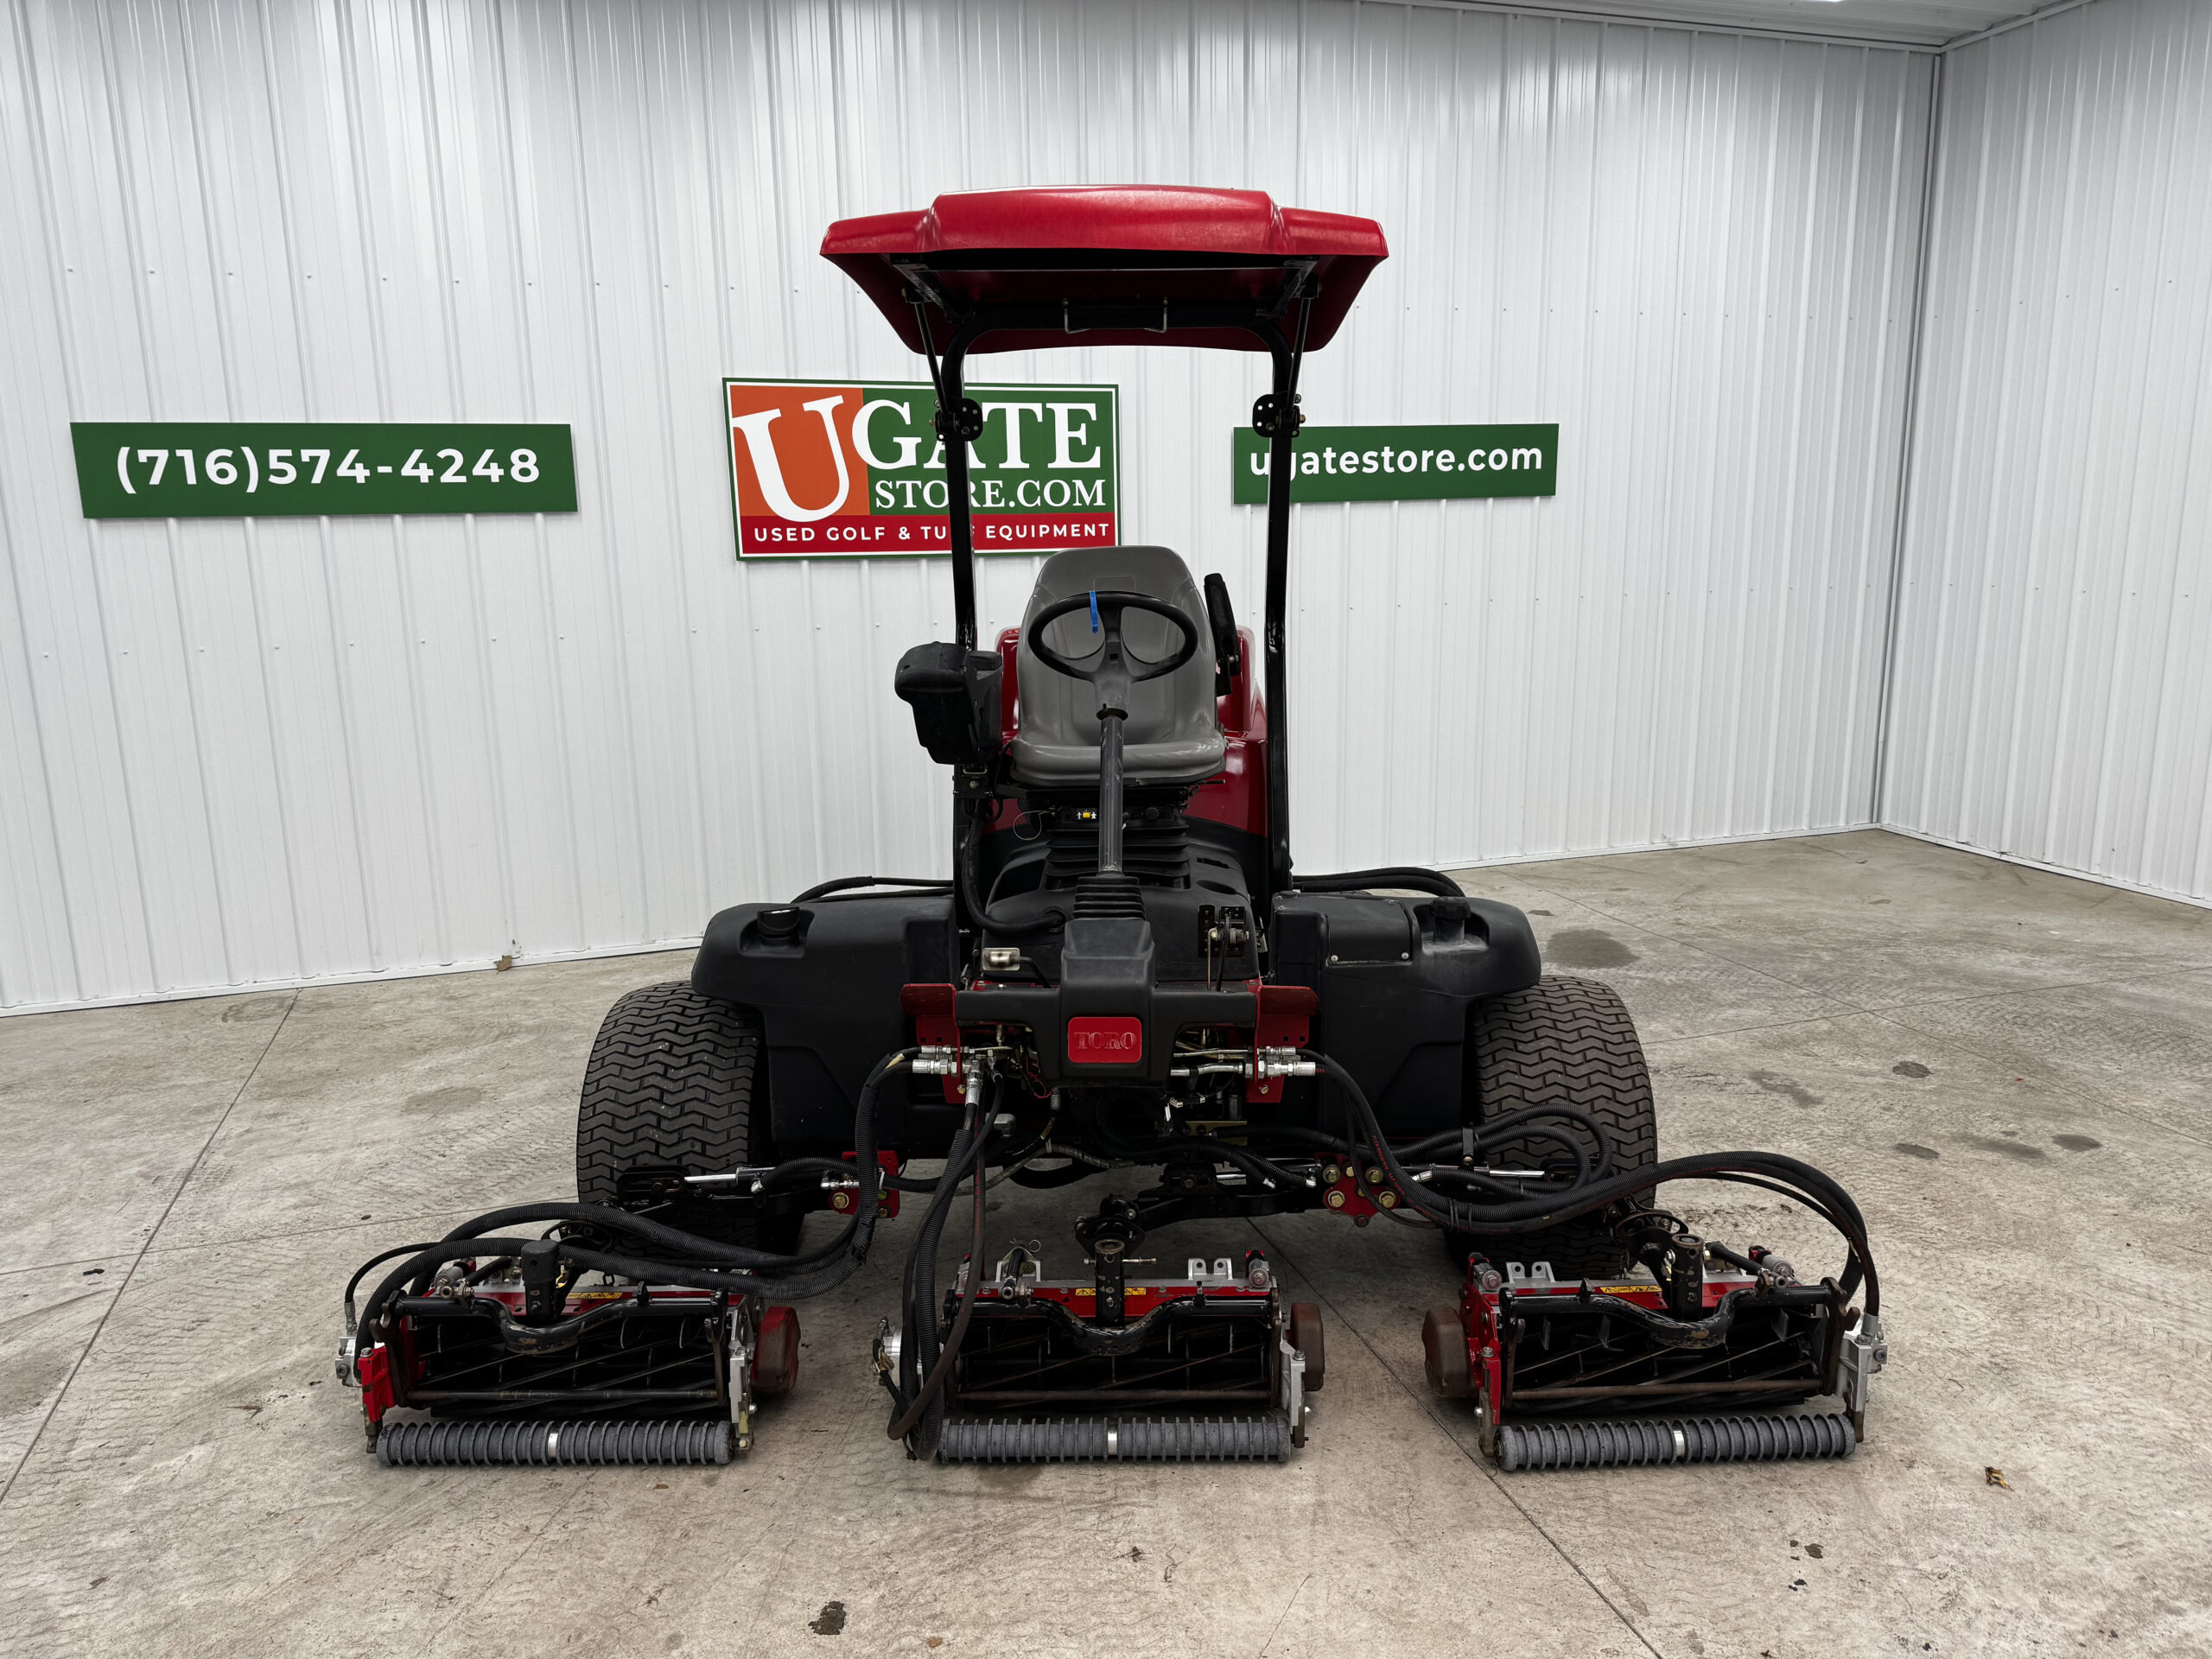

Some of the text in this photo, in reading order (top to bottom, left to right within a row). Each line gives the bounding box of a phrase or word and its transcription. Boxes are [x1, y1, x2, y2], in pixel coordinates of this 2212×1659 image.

[117, 446, 540, 494] (716)574-4248
[754, 523, 1109, 543] USED GOLF & TU EQUIPMENT
[1073, 1031, 1137, 1050] TORO
